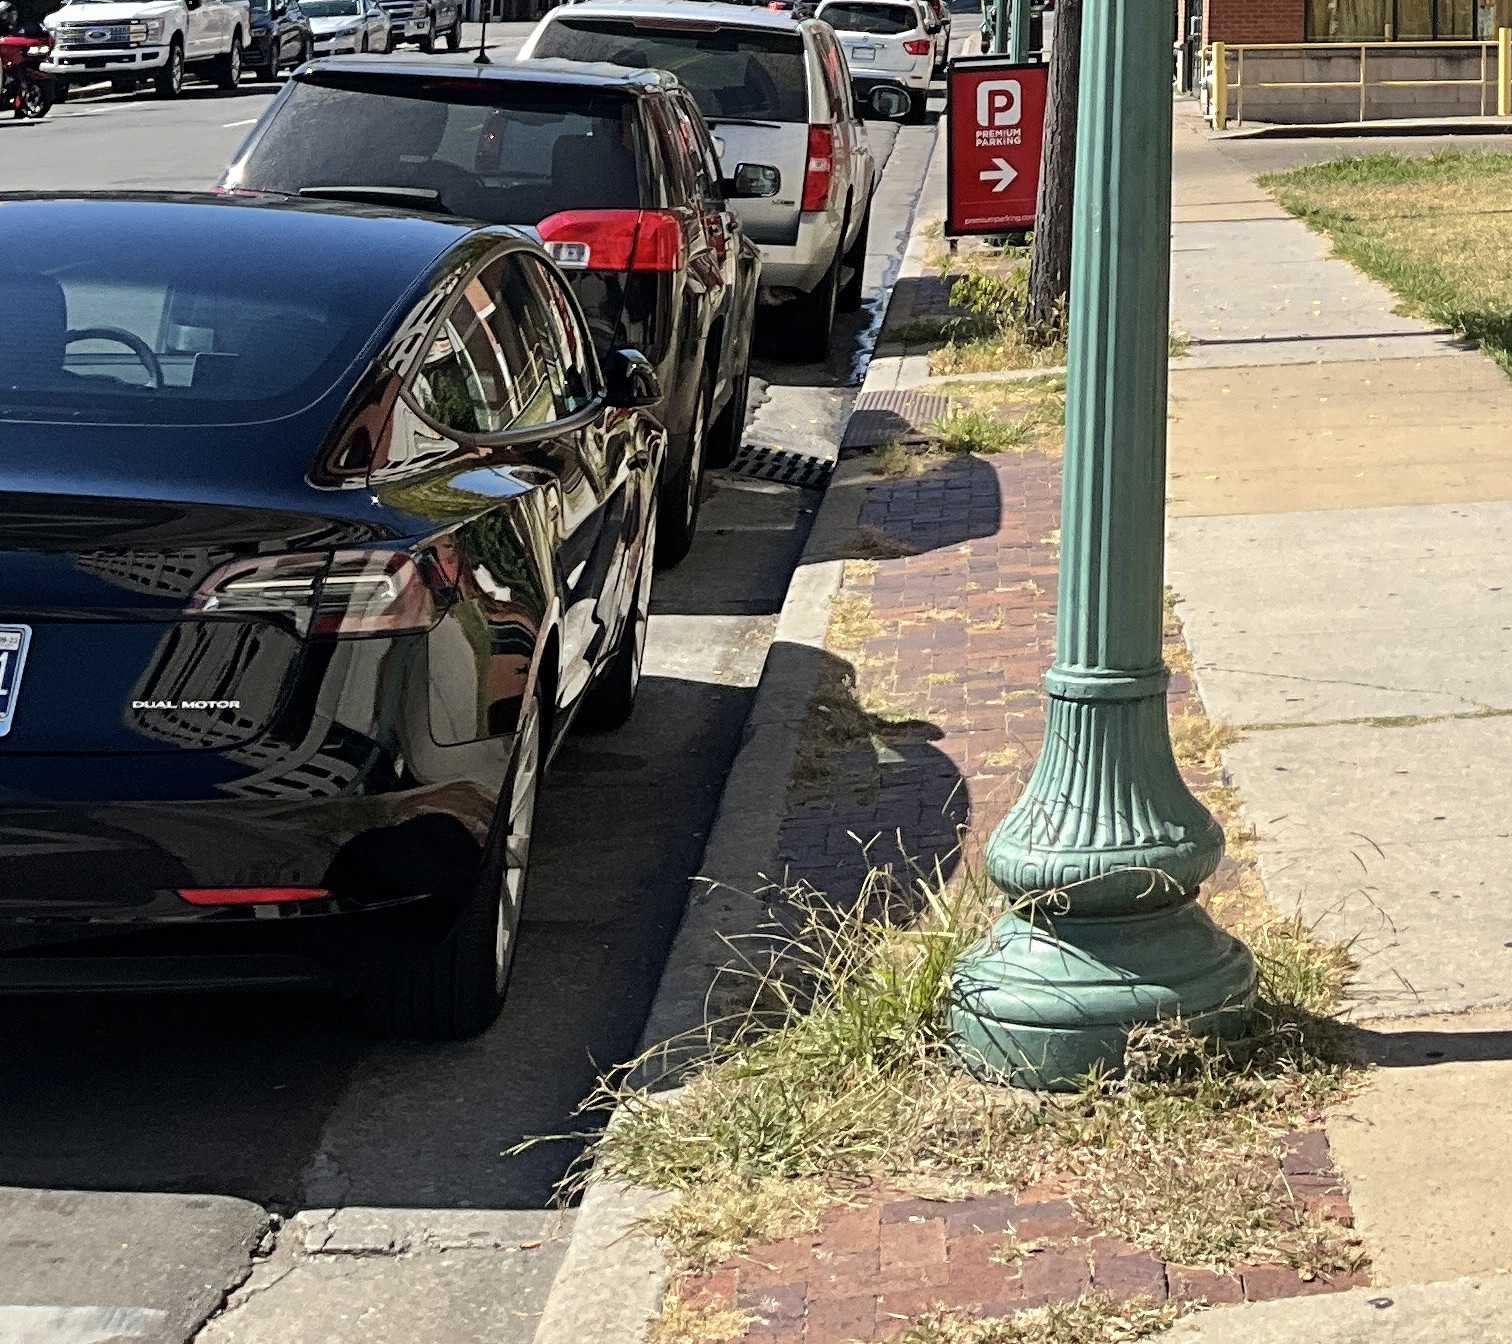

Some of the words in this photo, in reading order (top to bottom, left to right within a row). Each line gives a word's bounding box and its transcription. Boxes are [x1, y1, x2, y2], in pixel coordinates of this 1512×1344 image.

[976, 128, 1021, 139] PREMIUM
[976, 136, 1021, 146] PARKING
[132, 700, 177, 709] DUAL
[181, 700, 240, 709] MOTOR
